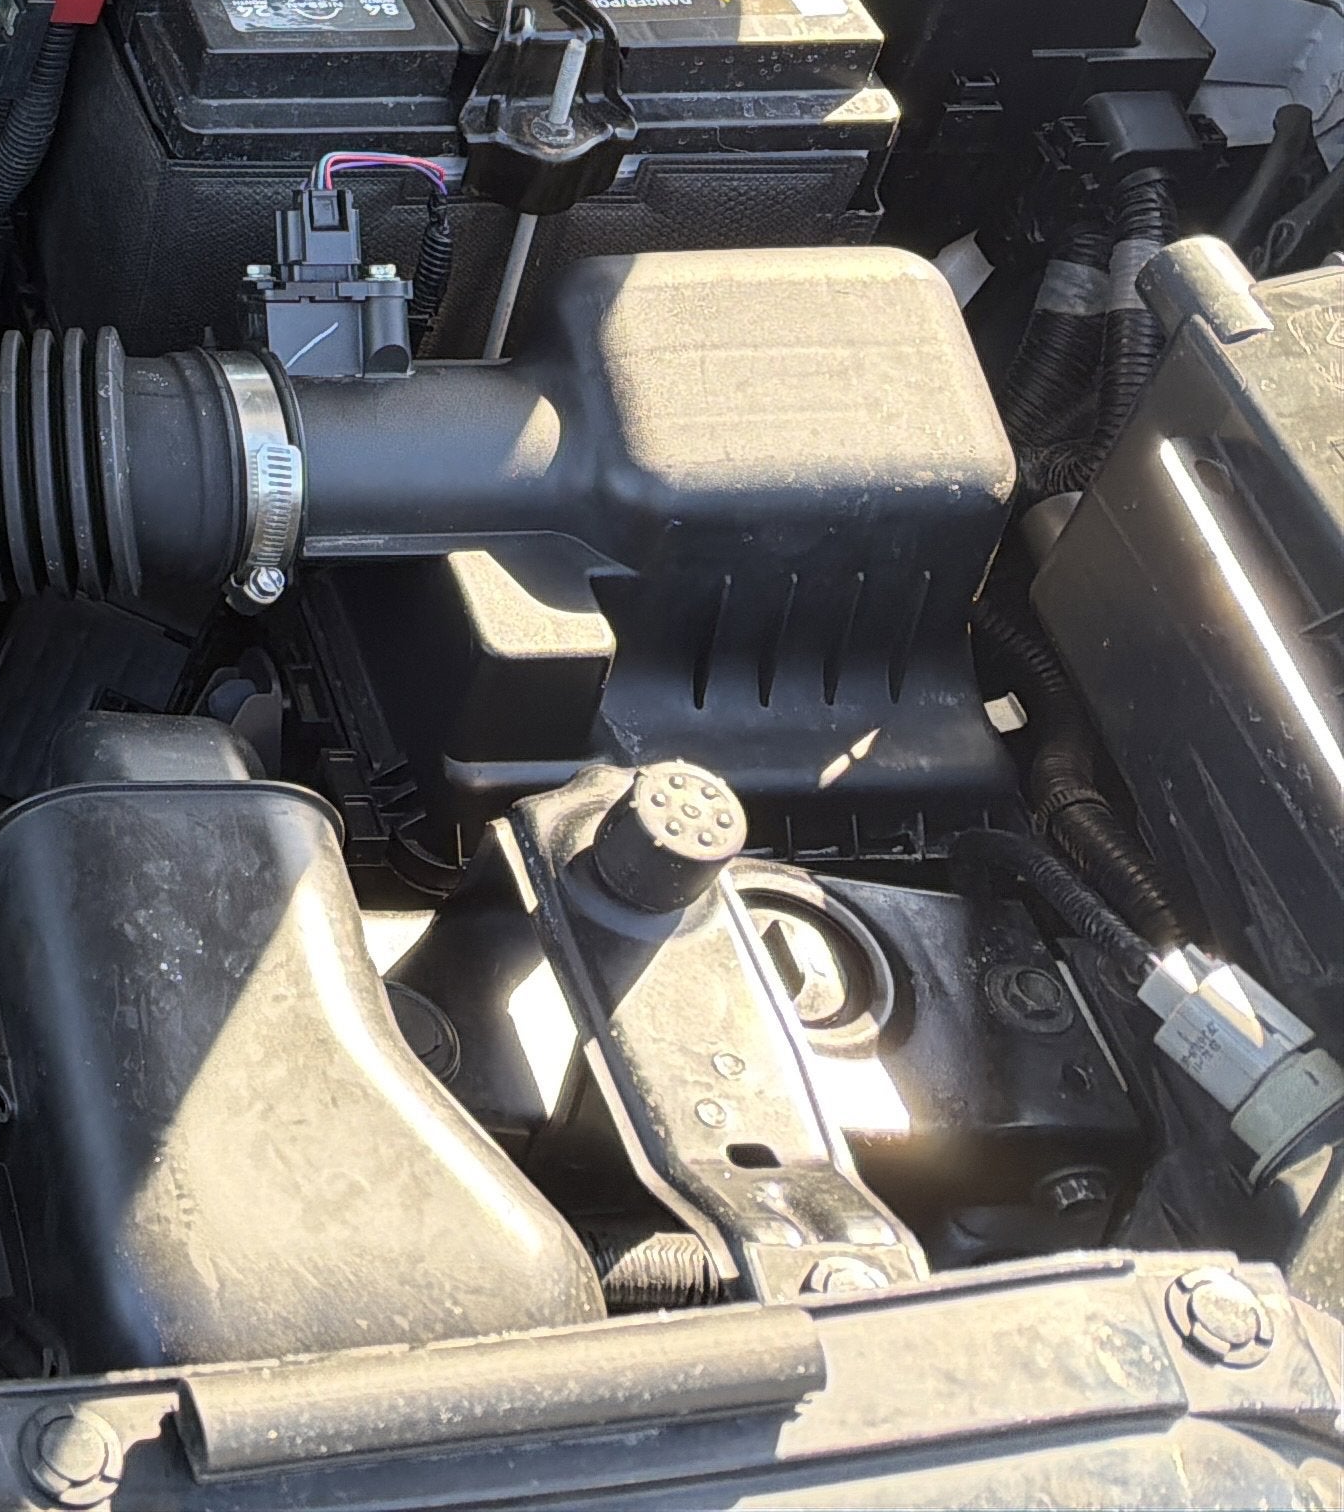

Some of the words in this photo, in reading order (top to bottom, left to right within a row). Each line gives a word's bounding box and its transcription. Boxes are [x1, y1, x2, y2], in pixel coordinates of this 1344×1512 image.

[287, 0, 343, 9] NISSAN
[364, 3, 399, 16] 84
[236, 5, 270, 17] 24
